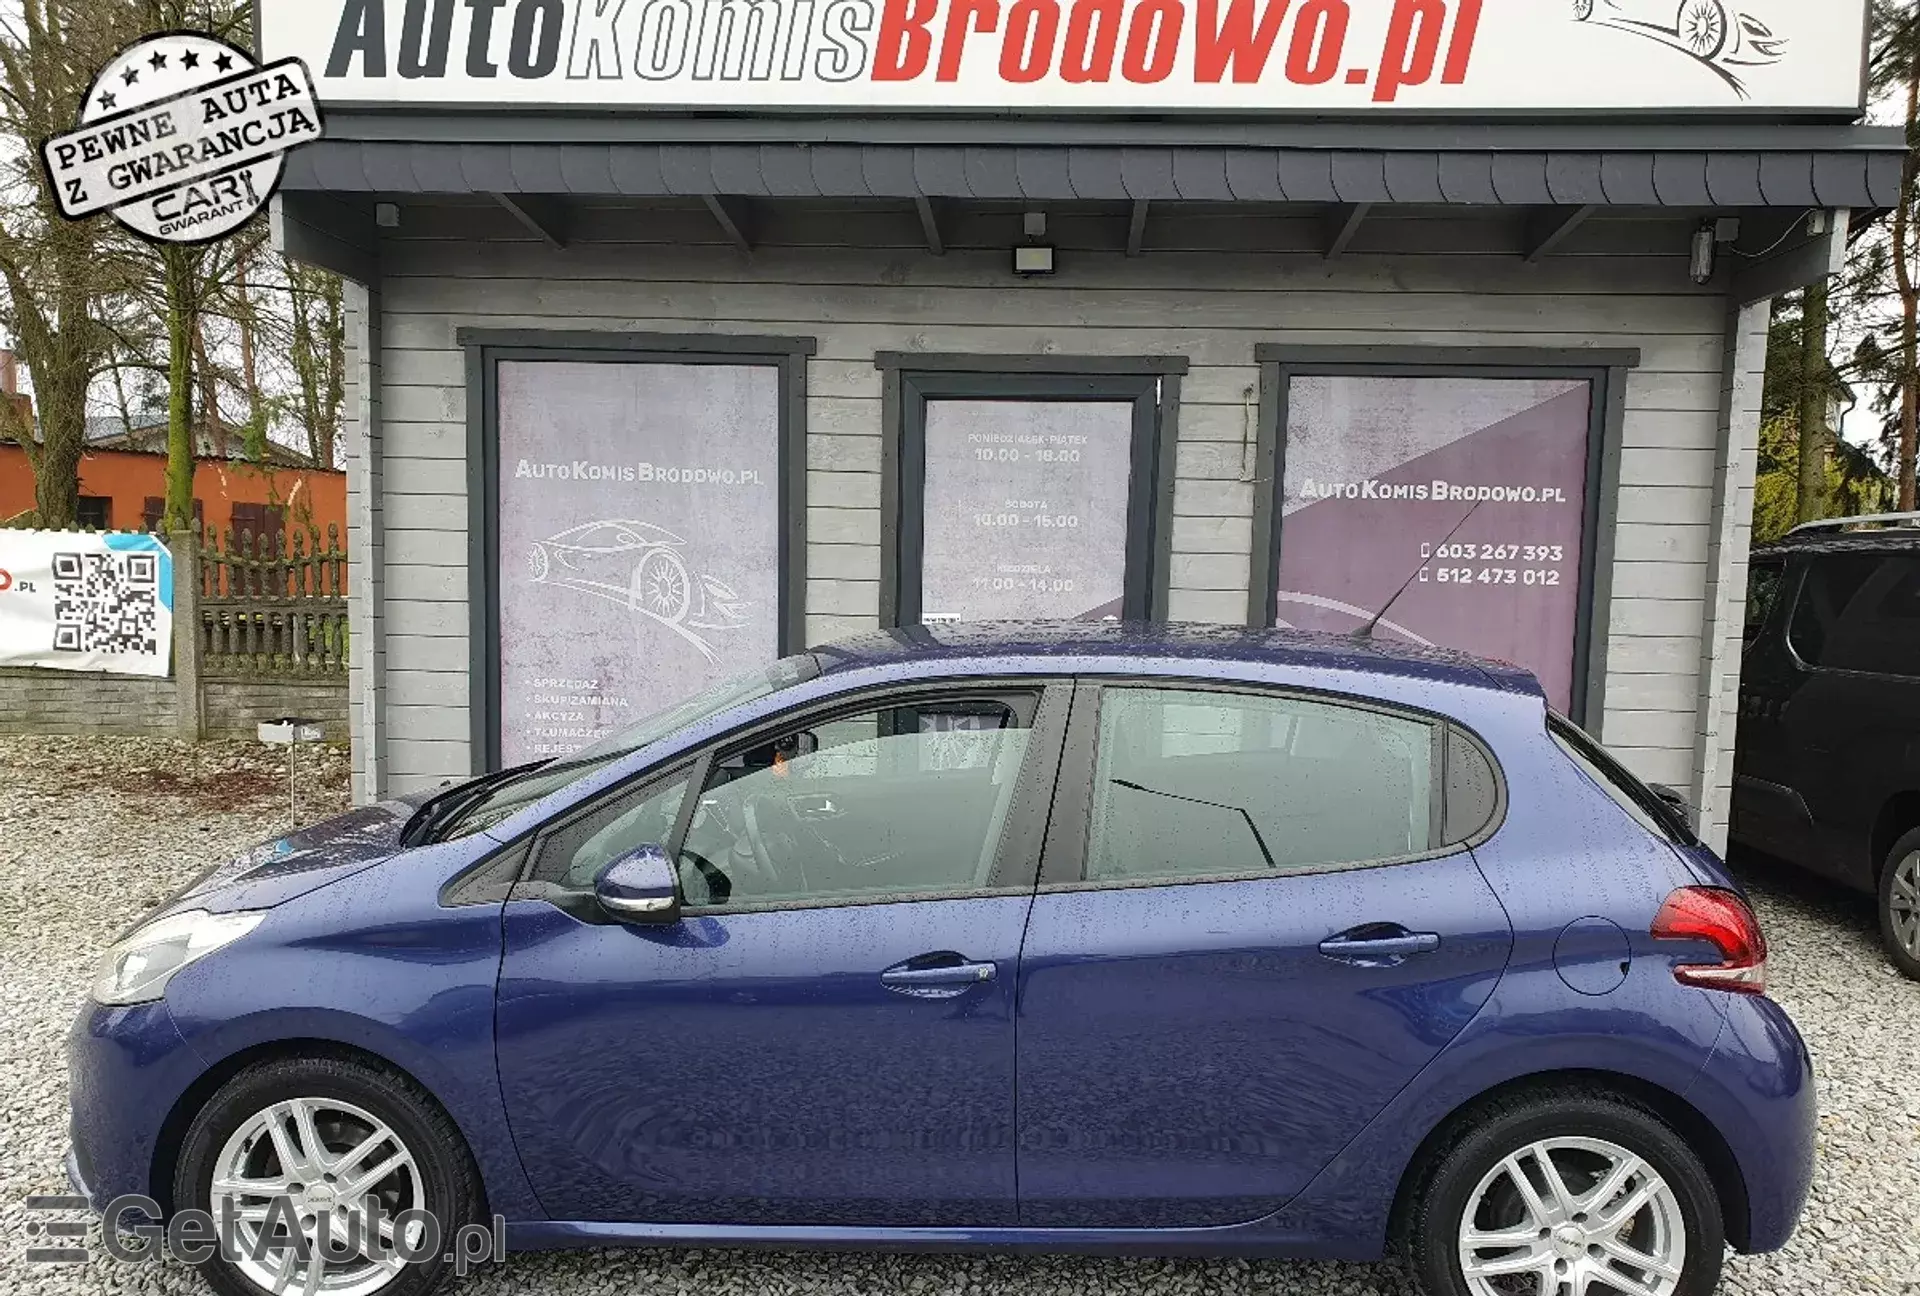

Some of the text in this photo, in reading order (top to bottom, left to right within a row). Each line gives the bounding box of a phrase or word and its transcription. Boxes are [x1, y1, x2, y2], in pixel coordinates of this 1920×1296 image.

[974, 448, 1019, 462] 10.00
[1004, 499, 1048, 510] SOBOTA
[974, 513, 1019, 527] 10.00
[1033, 514, 1078, 528] 15.00
[1436, 543, 1563, 561] 603 267 393
[1029, 577, 1074, 592] 14.00
[1436, 568, 1560, 586] 512 473 012
[534, 711, 584, 721] AKCYZA
